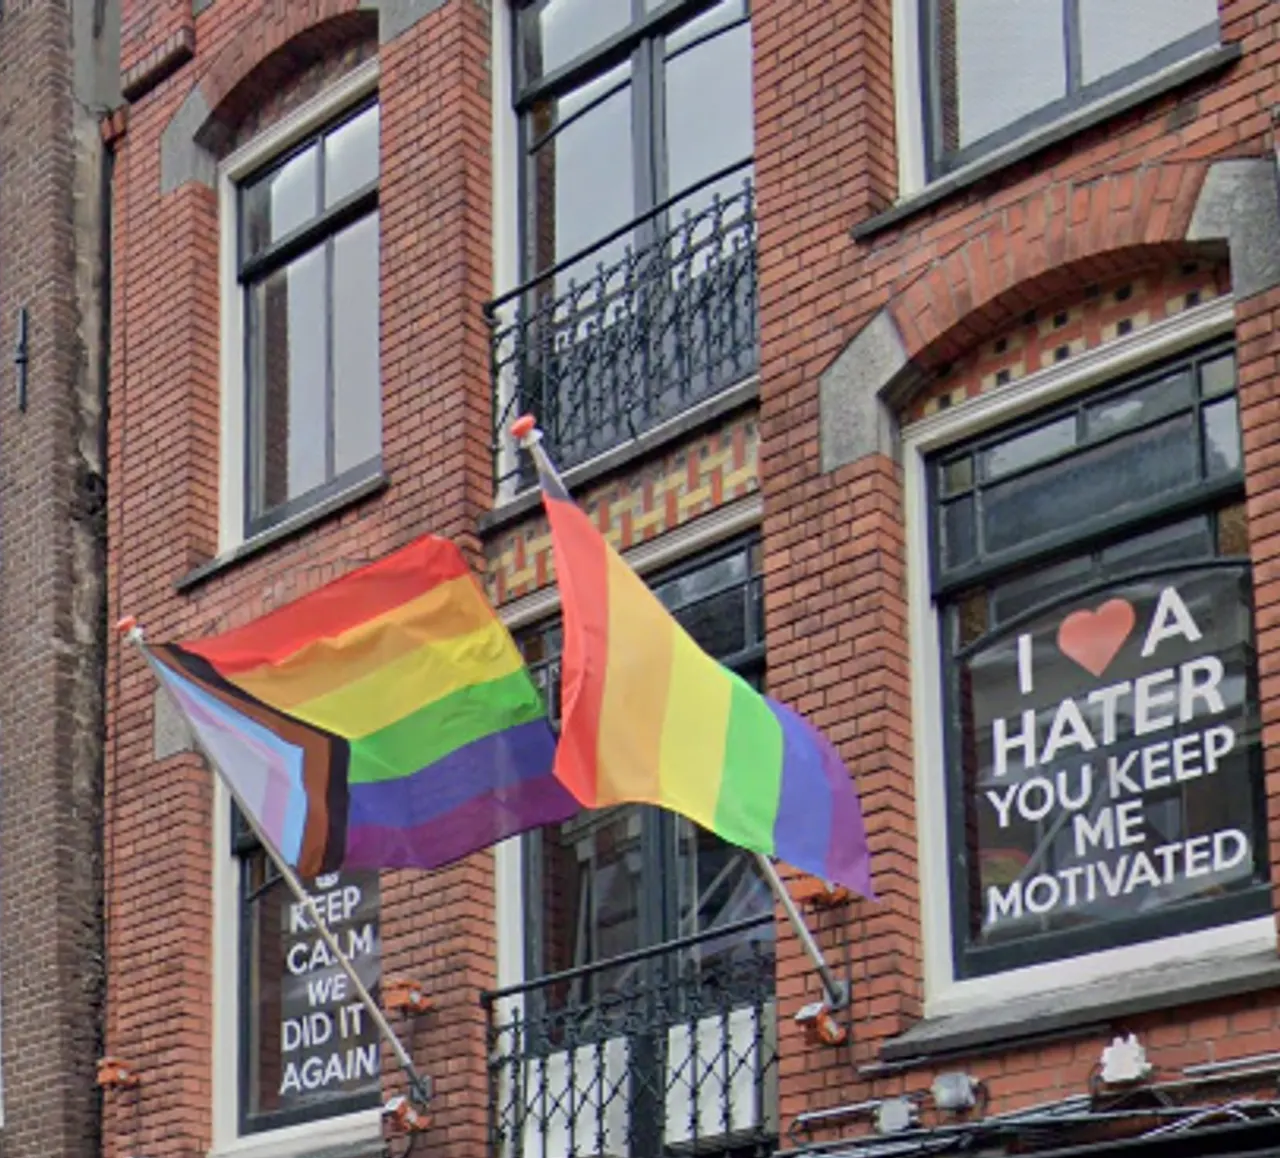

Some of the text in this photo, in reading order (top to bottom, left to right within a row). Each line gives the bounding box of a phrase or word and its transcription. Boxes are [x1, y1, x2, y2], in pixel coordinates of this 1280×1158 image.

[1018, 586, 1202, 694] I A
[993, 656, 1225, 777] HATER
[987, 726, 1235, 828] YOU KEEP
[1073, 800, 1146, 856] ME
[988, 829, 1247, 923] MOTIVATED
[290, 886, 360, 933] KEEP
[307, 974, 348, 1006] WE
[281, 1003, 365, 1052] DID IT
[279, 1044, 377, 1095] AGAIN
